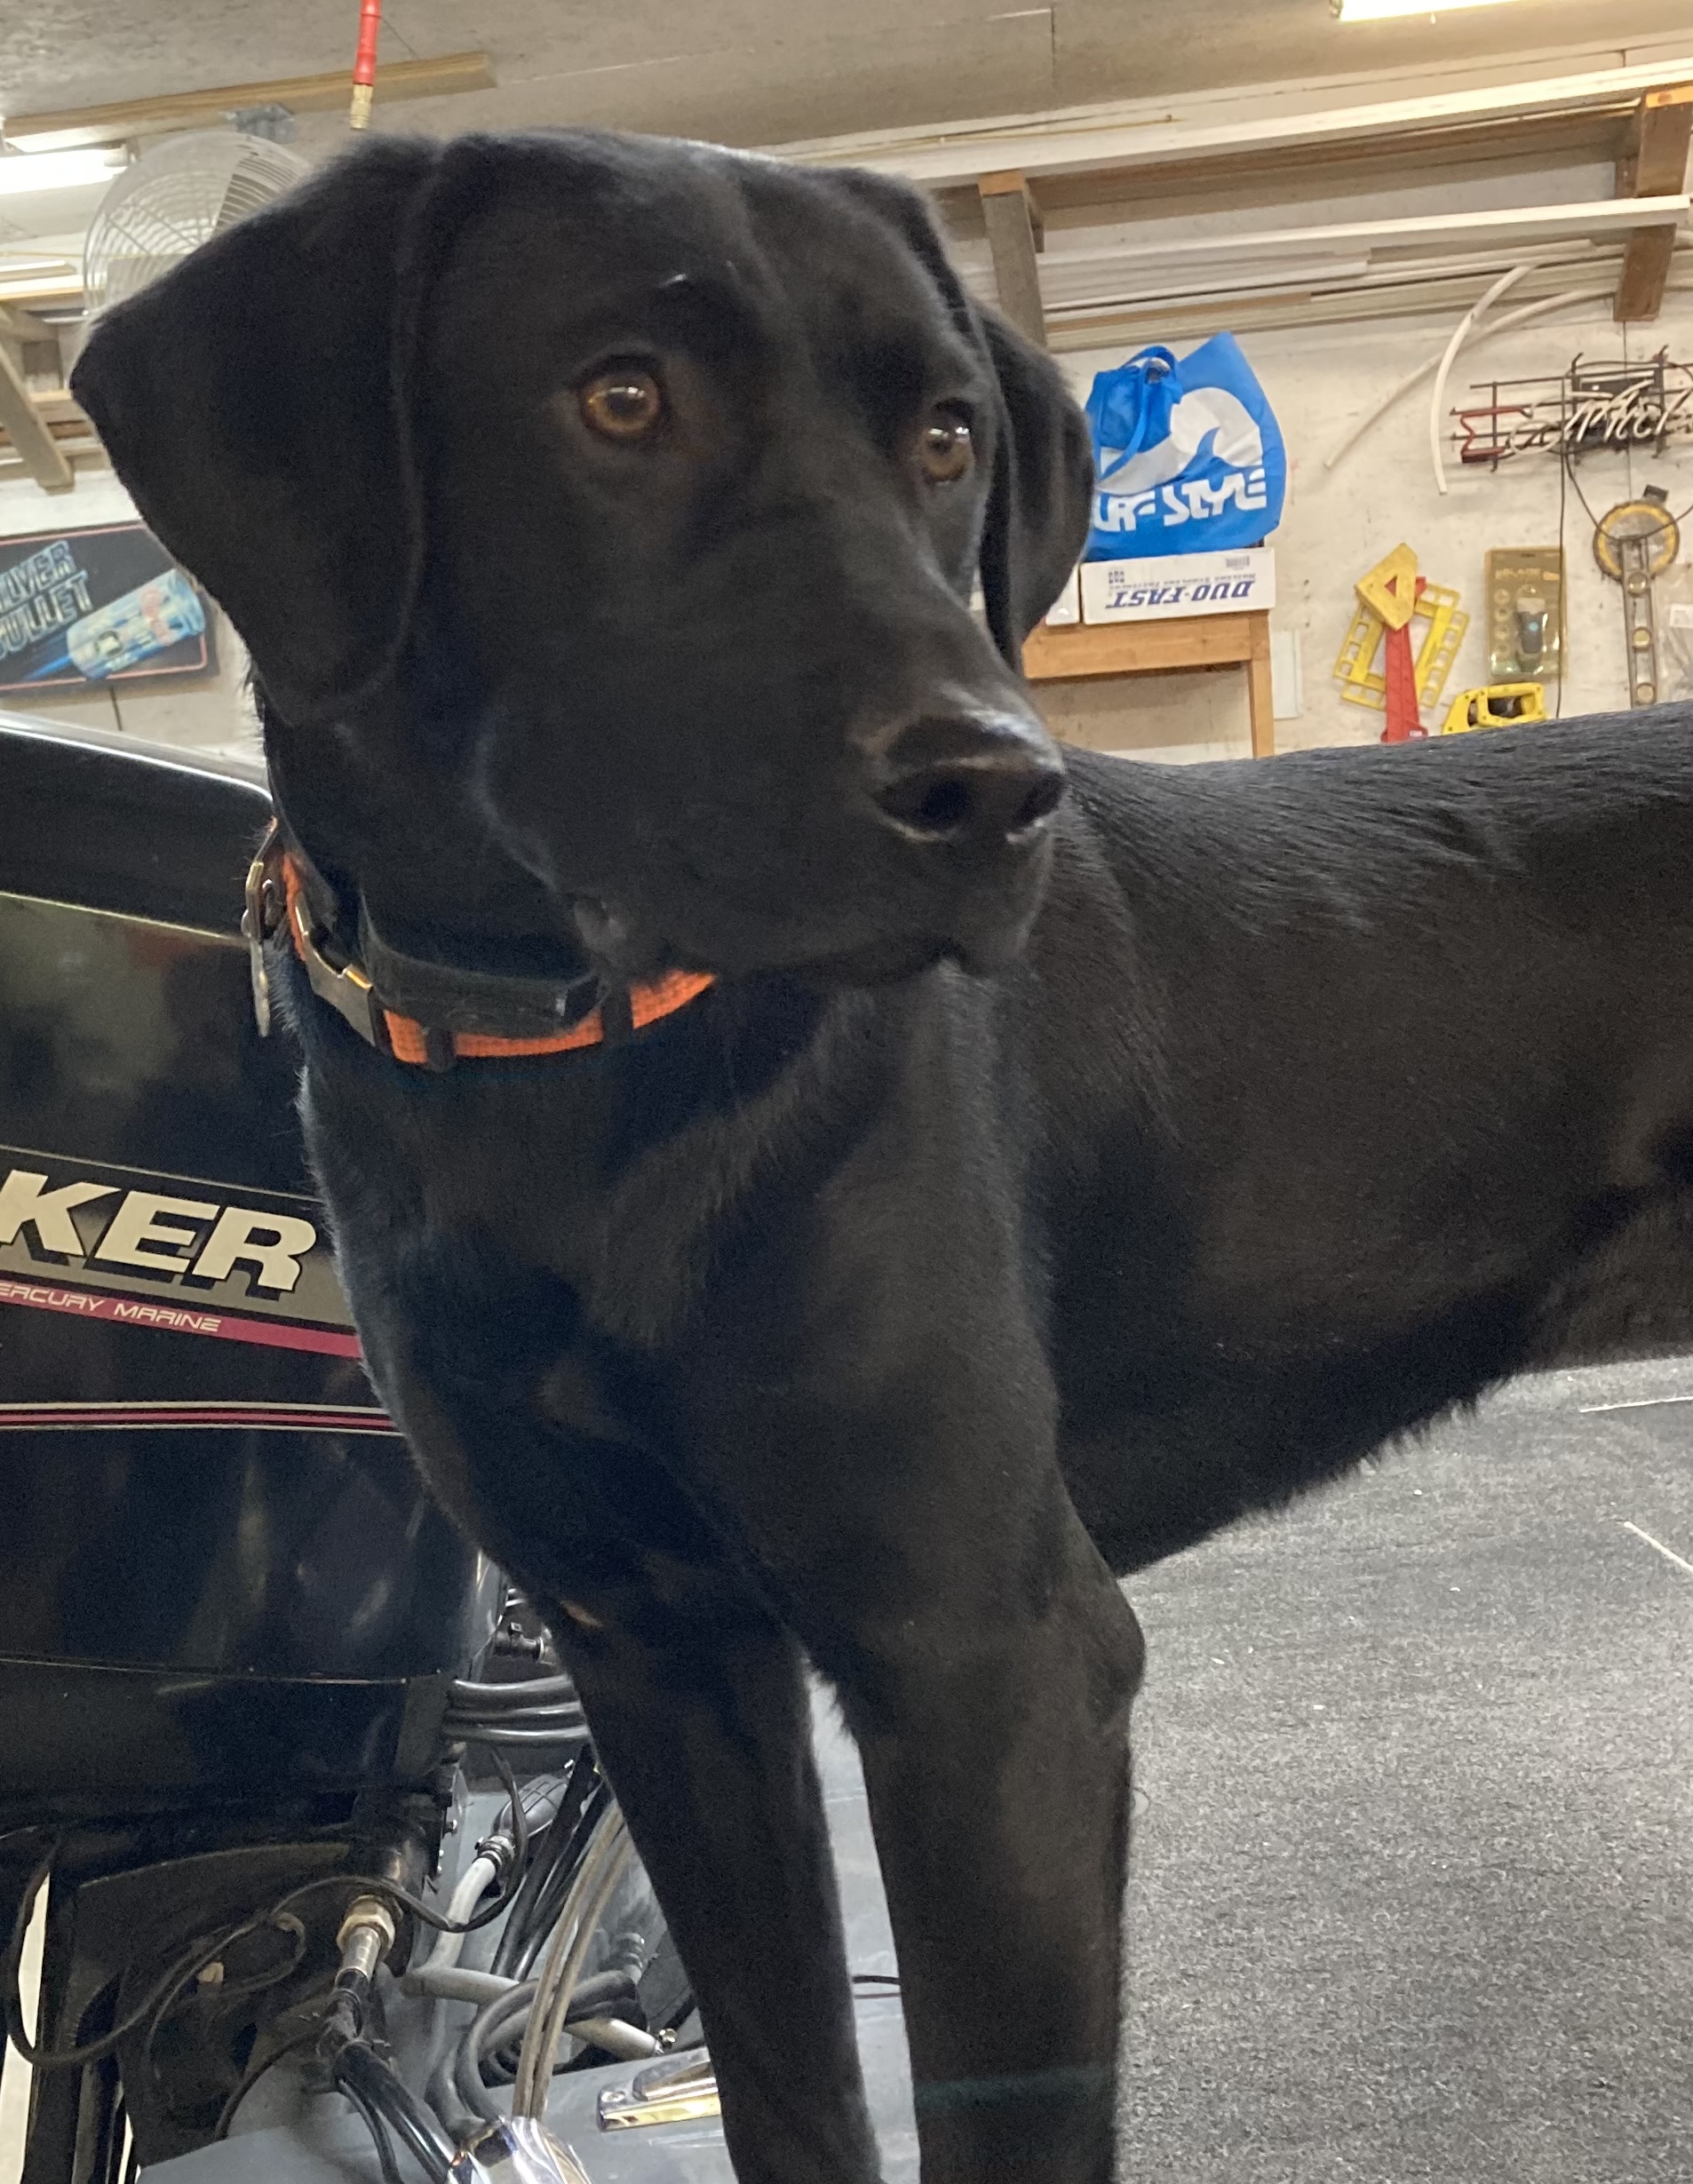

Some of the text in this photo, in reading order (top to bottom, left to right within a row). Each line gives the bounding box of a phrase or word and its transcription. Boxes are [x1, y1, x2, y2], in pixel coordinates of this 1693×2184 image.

[1104, 579, 1256, 609] DUO-FAST
[0, 1170, 317, 1292] KER
[114, 1303, 222, 1332] MARINE
